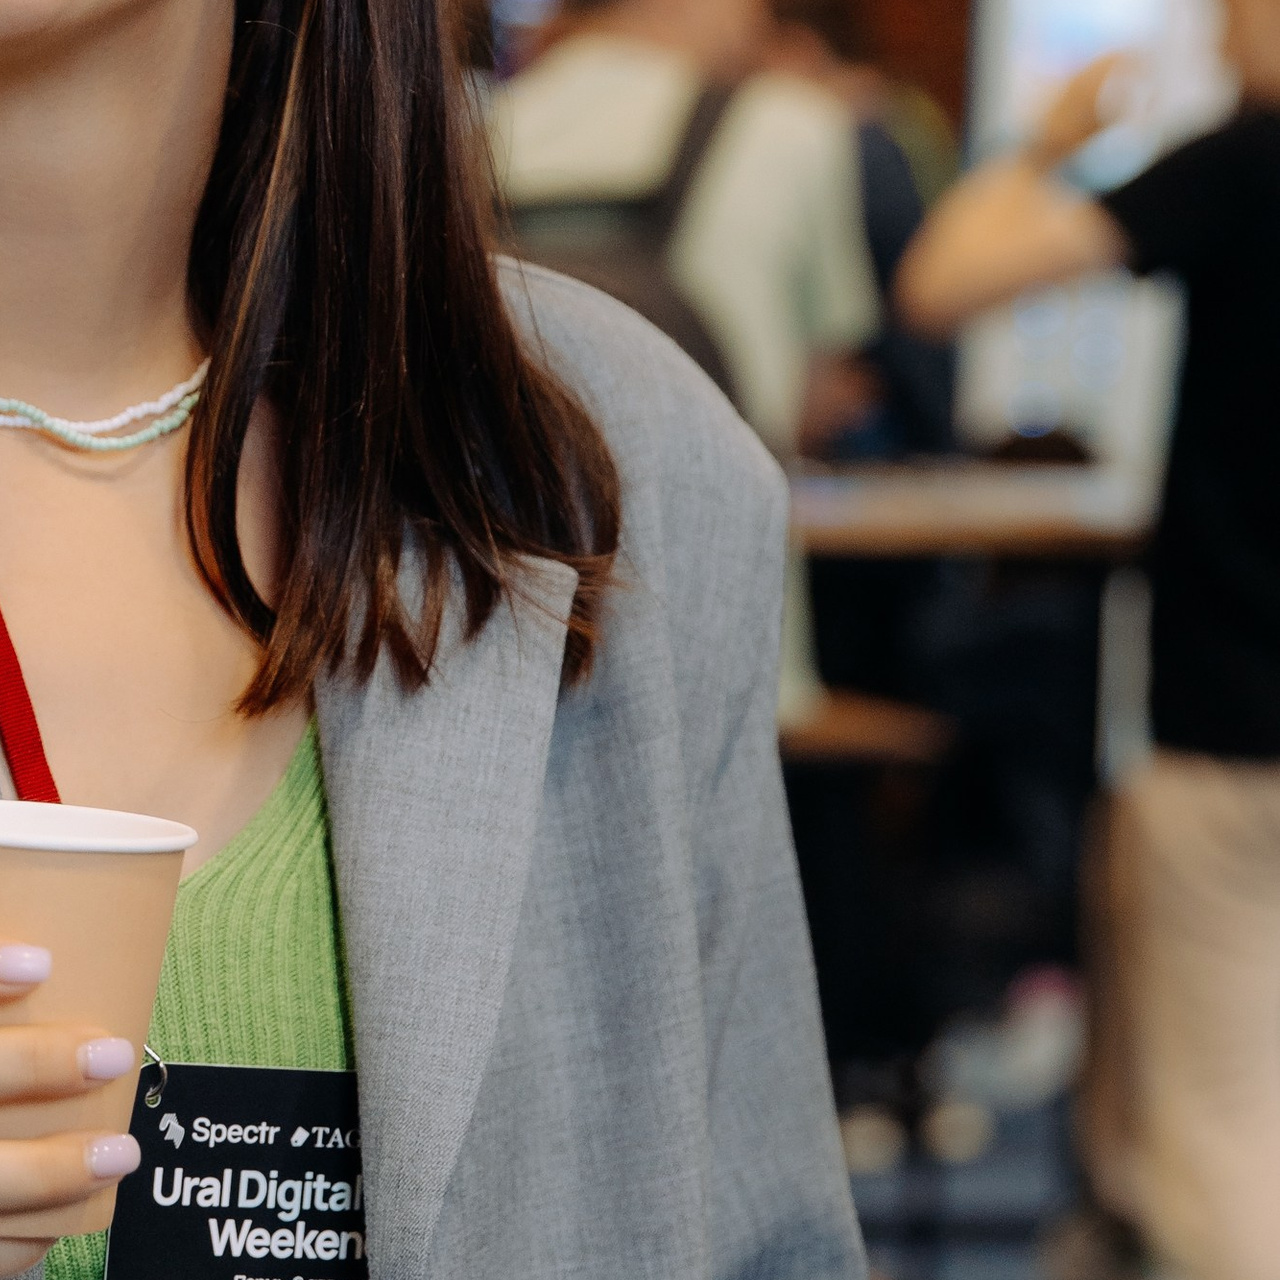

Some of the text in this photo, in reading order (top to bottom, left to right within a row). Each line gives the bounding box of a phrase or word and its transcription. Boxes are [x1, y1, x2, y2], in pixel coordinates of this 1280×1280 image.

[191, 1117, 280, 1148] Spectr
[152, 1167, 363, 1222] Ural Digital
[208, 1218, 366, 1261] Weeken
